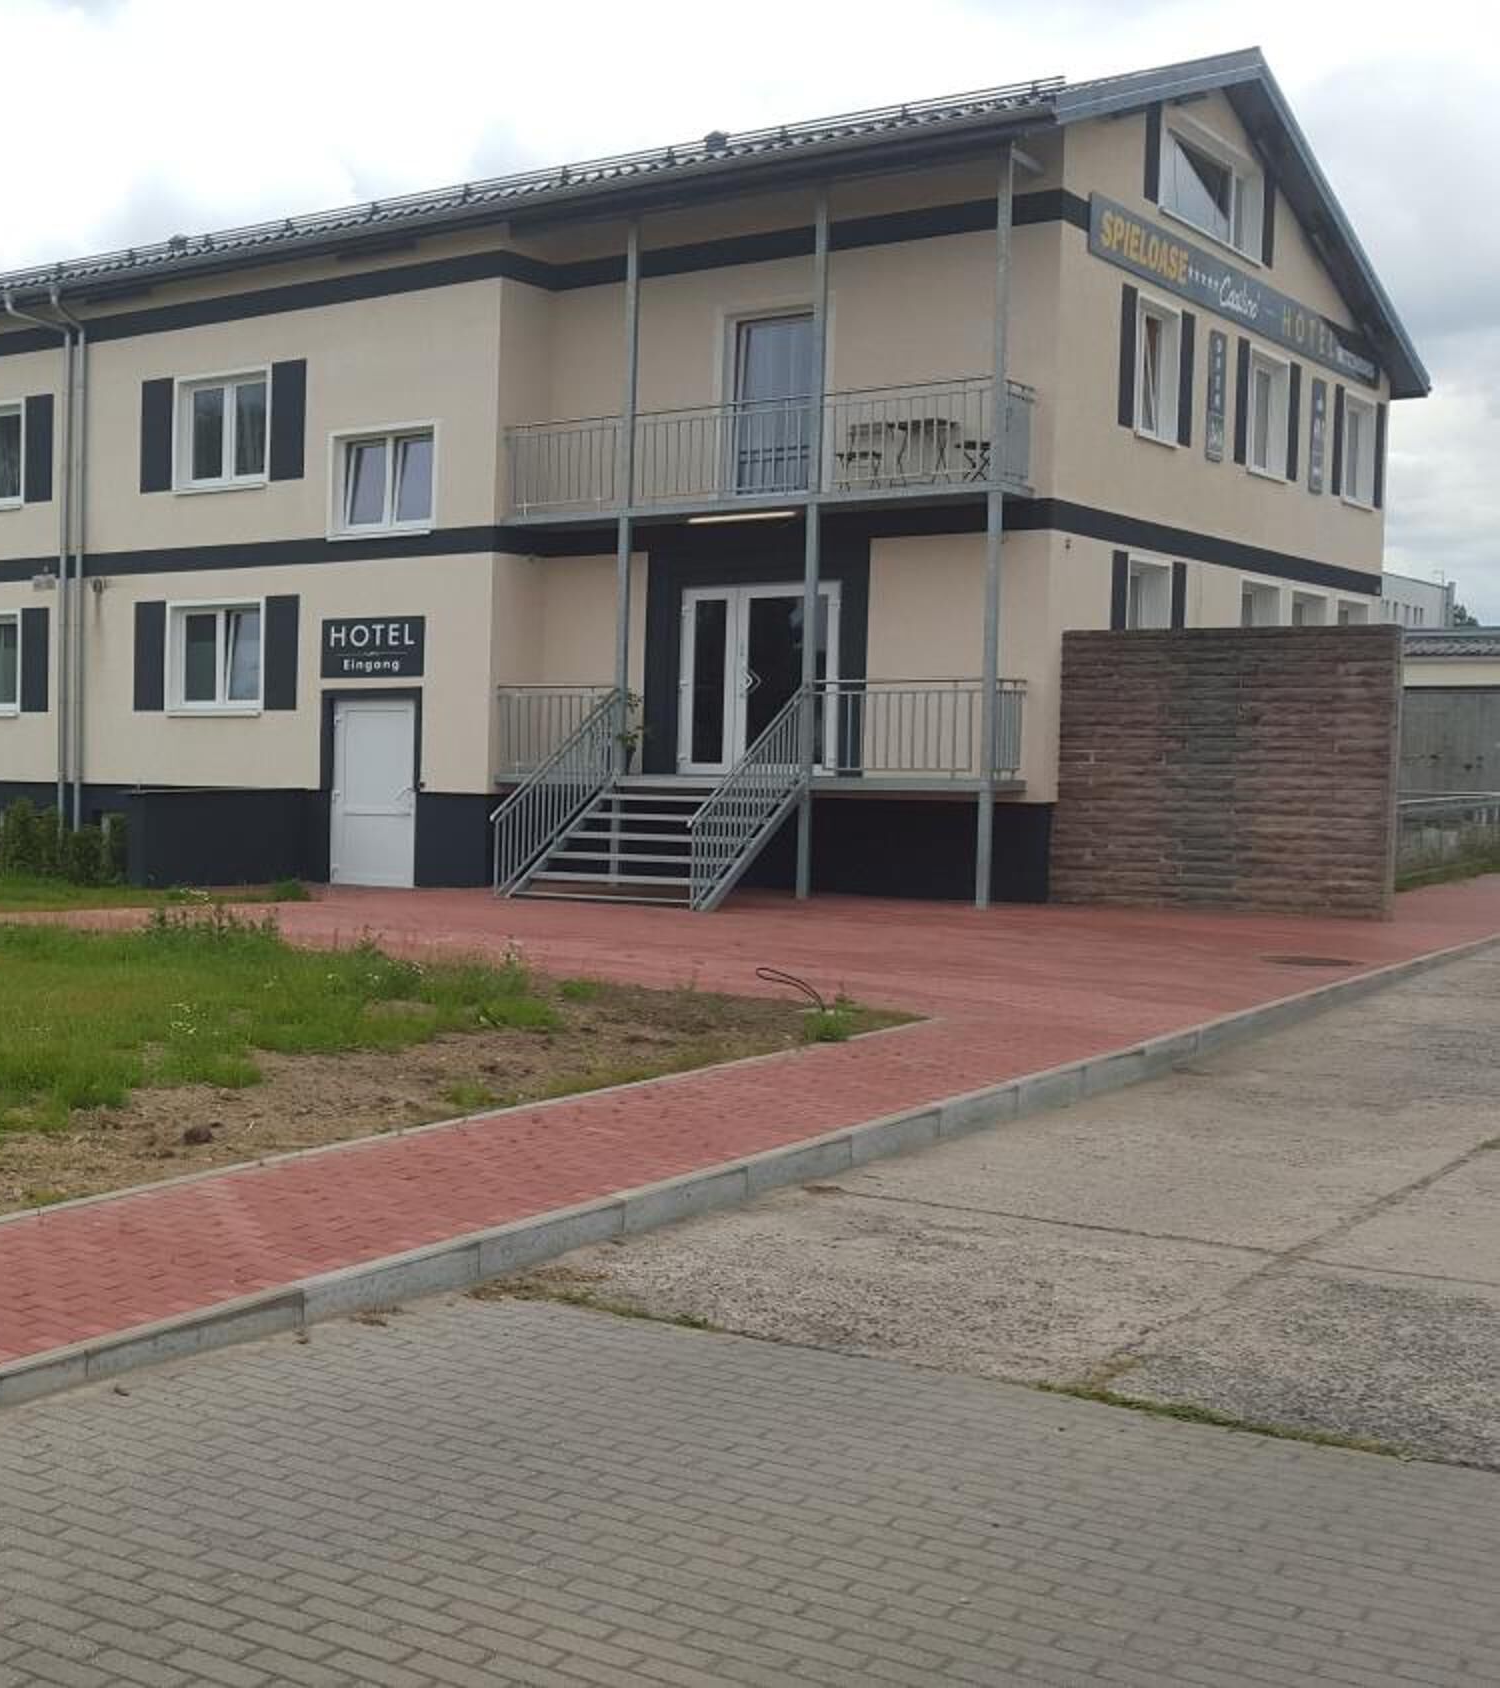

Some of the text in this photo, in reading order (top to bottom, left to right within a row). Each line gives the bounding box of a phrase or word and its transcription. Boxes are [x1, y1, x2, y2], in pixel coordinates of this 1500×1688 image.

[1100, 209, 1190, 286] SPIELOASE
[330, 624, 415, 647] HOTEL
[342, 658, 400, 672] Eingang
